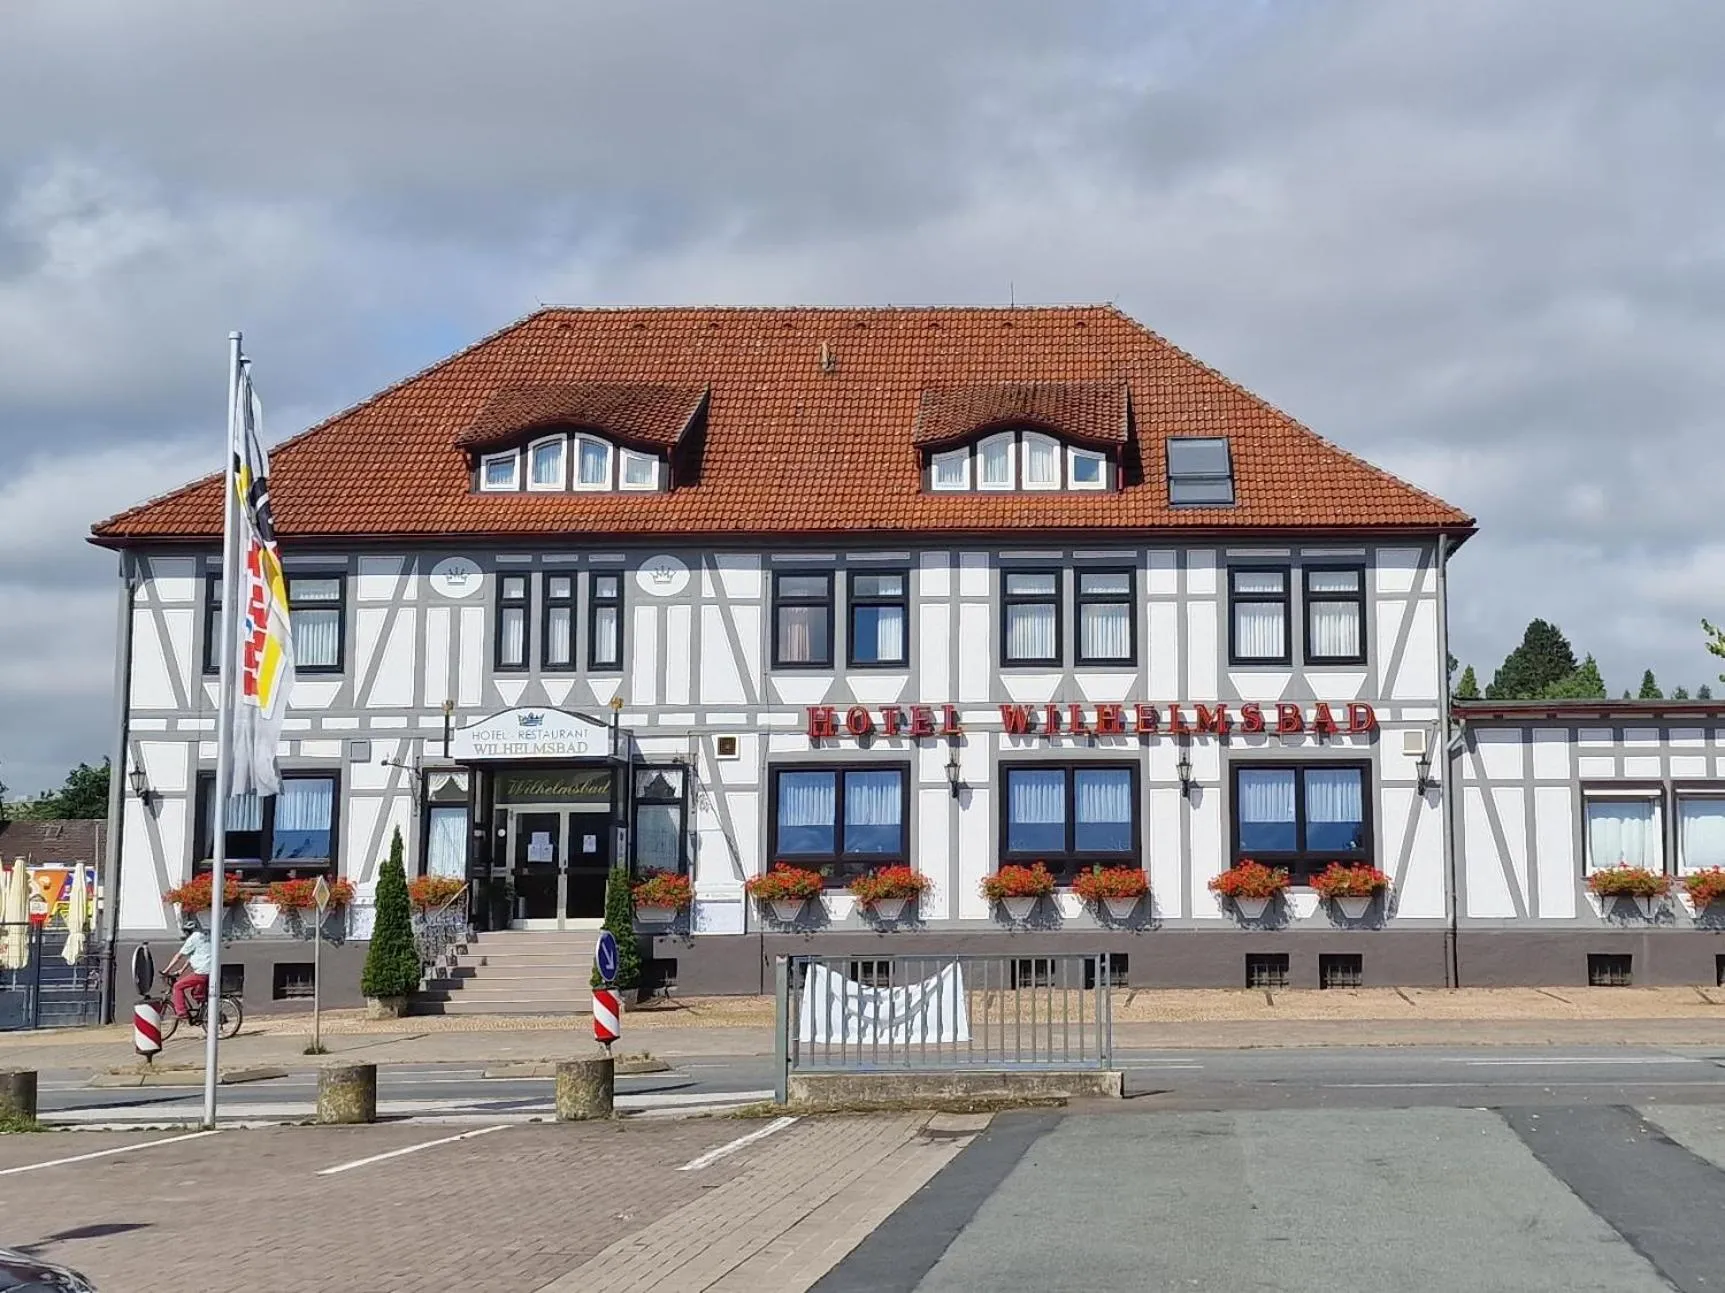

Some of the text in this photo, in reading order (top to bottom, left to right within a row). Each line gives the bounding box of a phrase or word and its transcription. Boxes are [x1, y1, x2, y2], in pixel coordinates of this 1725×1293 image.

[806, 702, 1376, 737] HOTEL WILHELMSBAD
[472, 728, 589, 741] HOTEL RESTAURANT
[473, 742, 589, 755] WILHELMSBAD
[506, 777, 611, 796] Wilhelmsbad
